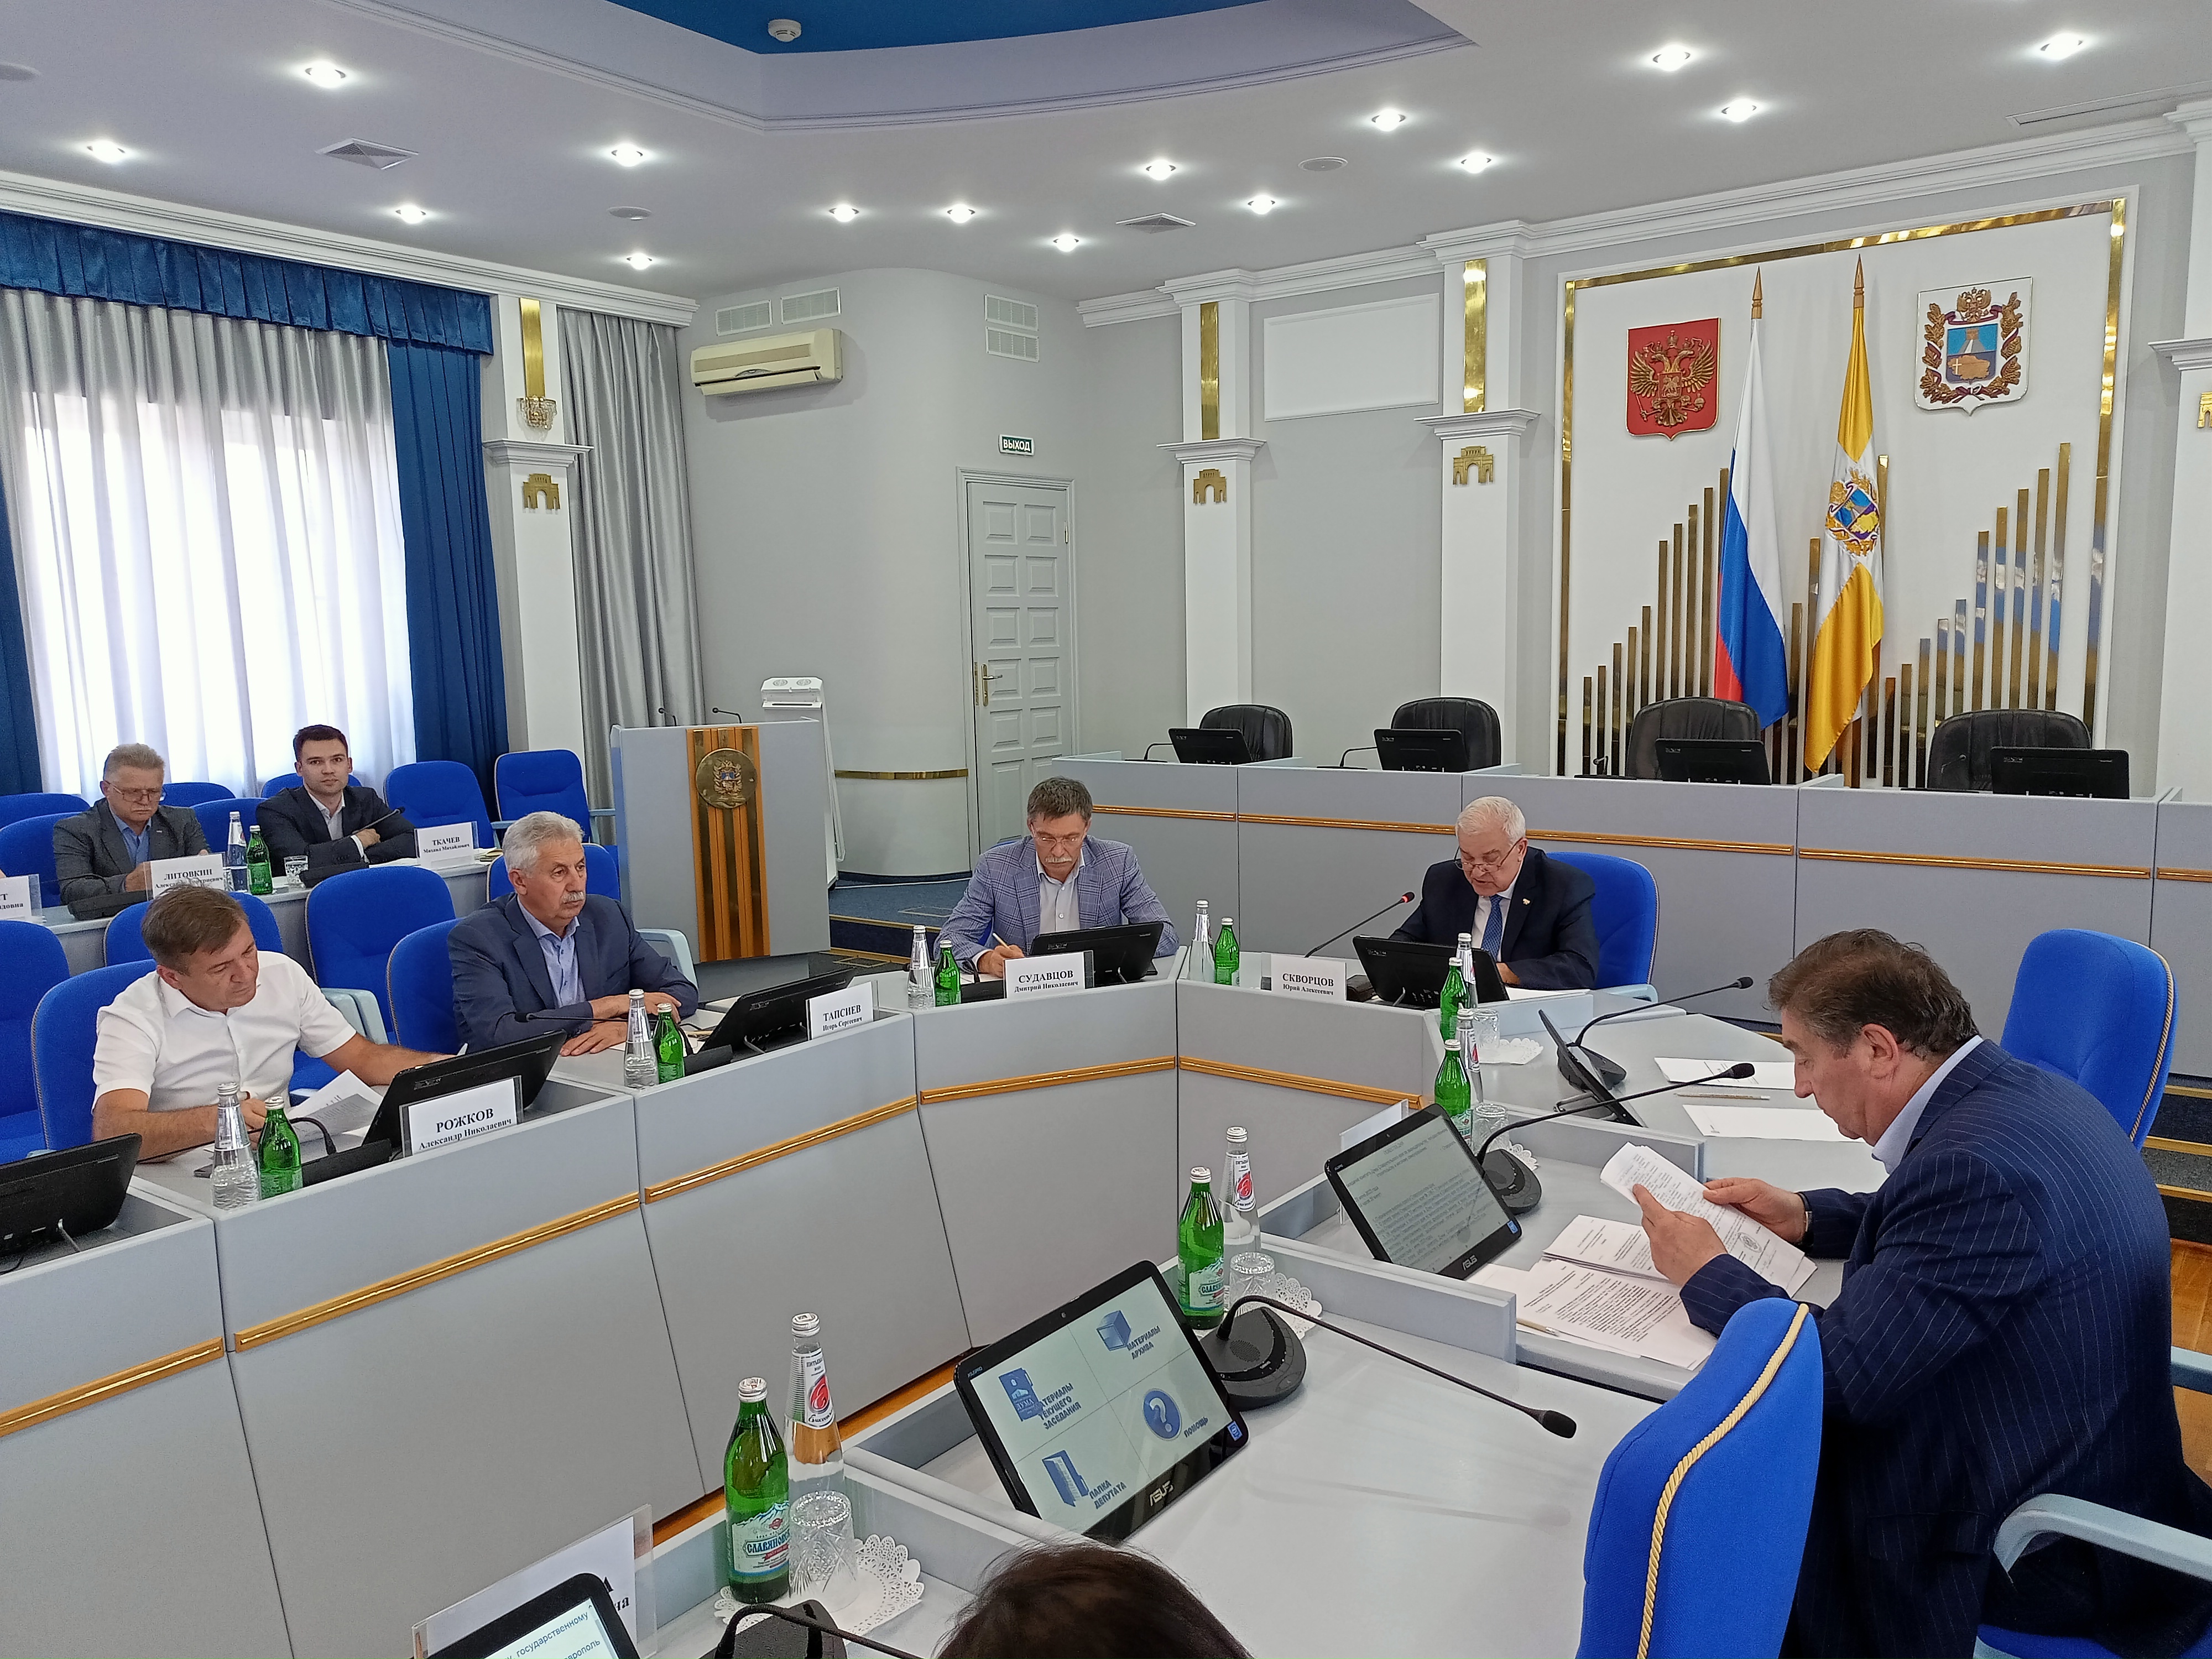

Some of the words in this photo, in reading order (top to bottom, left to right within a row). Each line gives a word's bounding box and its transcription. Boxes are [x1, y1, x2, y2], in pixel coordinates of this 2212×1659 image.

[1003, 439, 1031, 451] ВЫХОД
[432, 837, 460, 846] ТКАЧЕВ
[164, 869, 212, 880] ЛИТОВКИН
[1019, 971, 1073, 983] СУДАВЦОВ
[1282, 973, 1334, 987] СКВОРЦОВ
[1014, 984, 1041, 993] Дмитрий
[1043, 981, 1078, 989] Николаевич
[1301, 987, 1334, 995] Алексеевич
[823, 1005, 861, 1021] ТАПСИЕВ
[838, 1017, 862, 1027] Сергеевич
[436, 1108, 494, 1133] РОЖКОВ
[419, 1133, 462, 1150] Александр
[465, 1119, 512, 1136] Николаевич
[1462, 1255, 1478, 1270] ASUS
[1126, 1325, 1161, 1351] МАТЕРИАЛЫ
[1131, 1341, 1154, 1360] АРХИВА
[1039, 1383, 1074, 1407] АТЕРИАЛЫ
[1038, 1396, 1072, 1421] ТЕКУЩЕГО
[1043, 1401, 1082, 1430] ЗАСЕДАНИЯ
[1184, 1416, 1208, 1438] ПОМОЩЬ
[1089, 1480, 1112, 1499] ПАПКА
[1094, 1481, 1127, 1510] ДЕПУТАТА
[1149, 1480, 1174, 1507] ASUS
[517, 1611, 588, 1657] государственному
